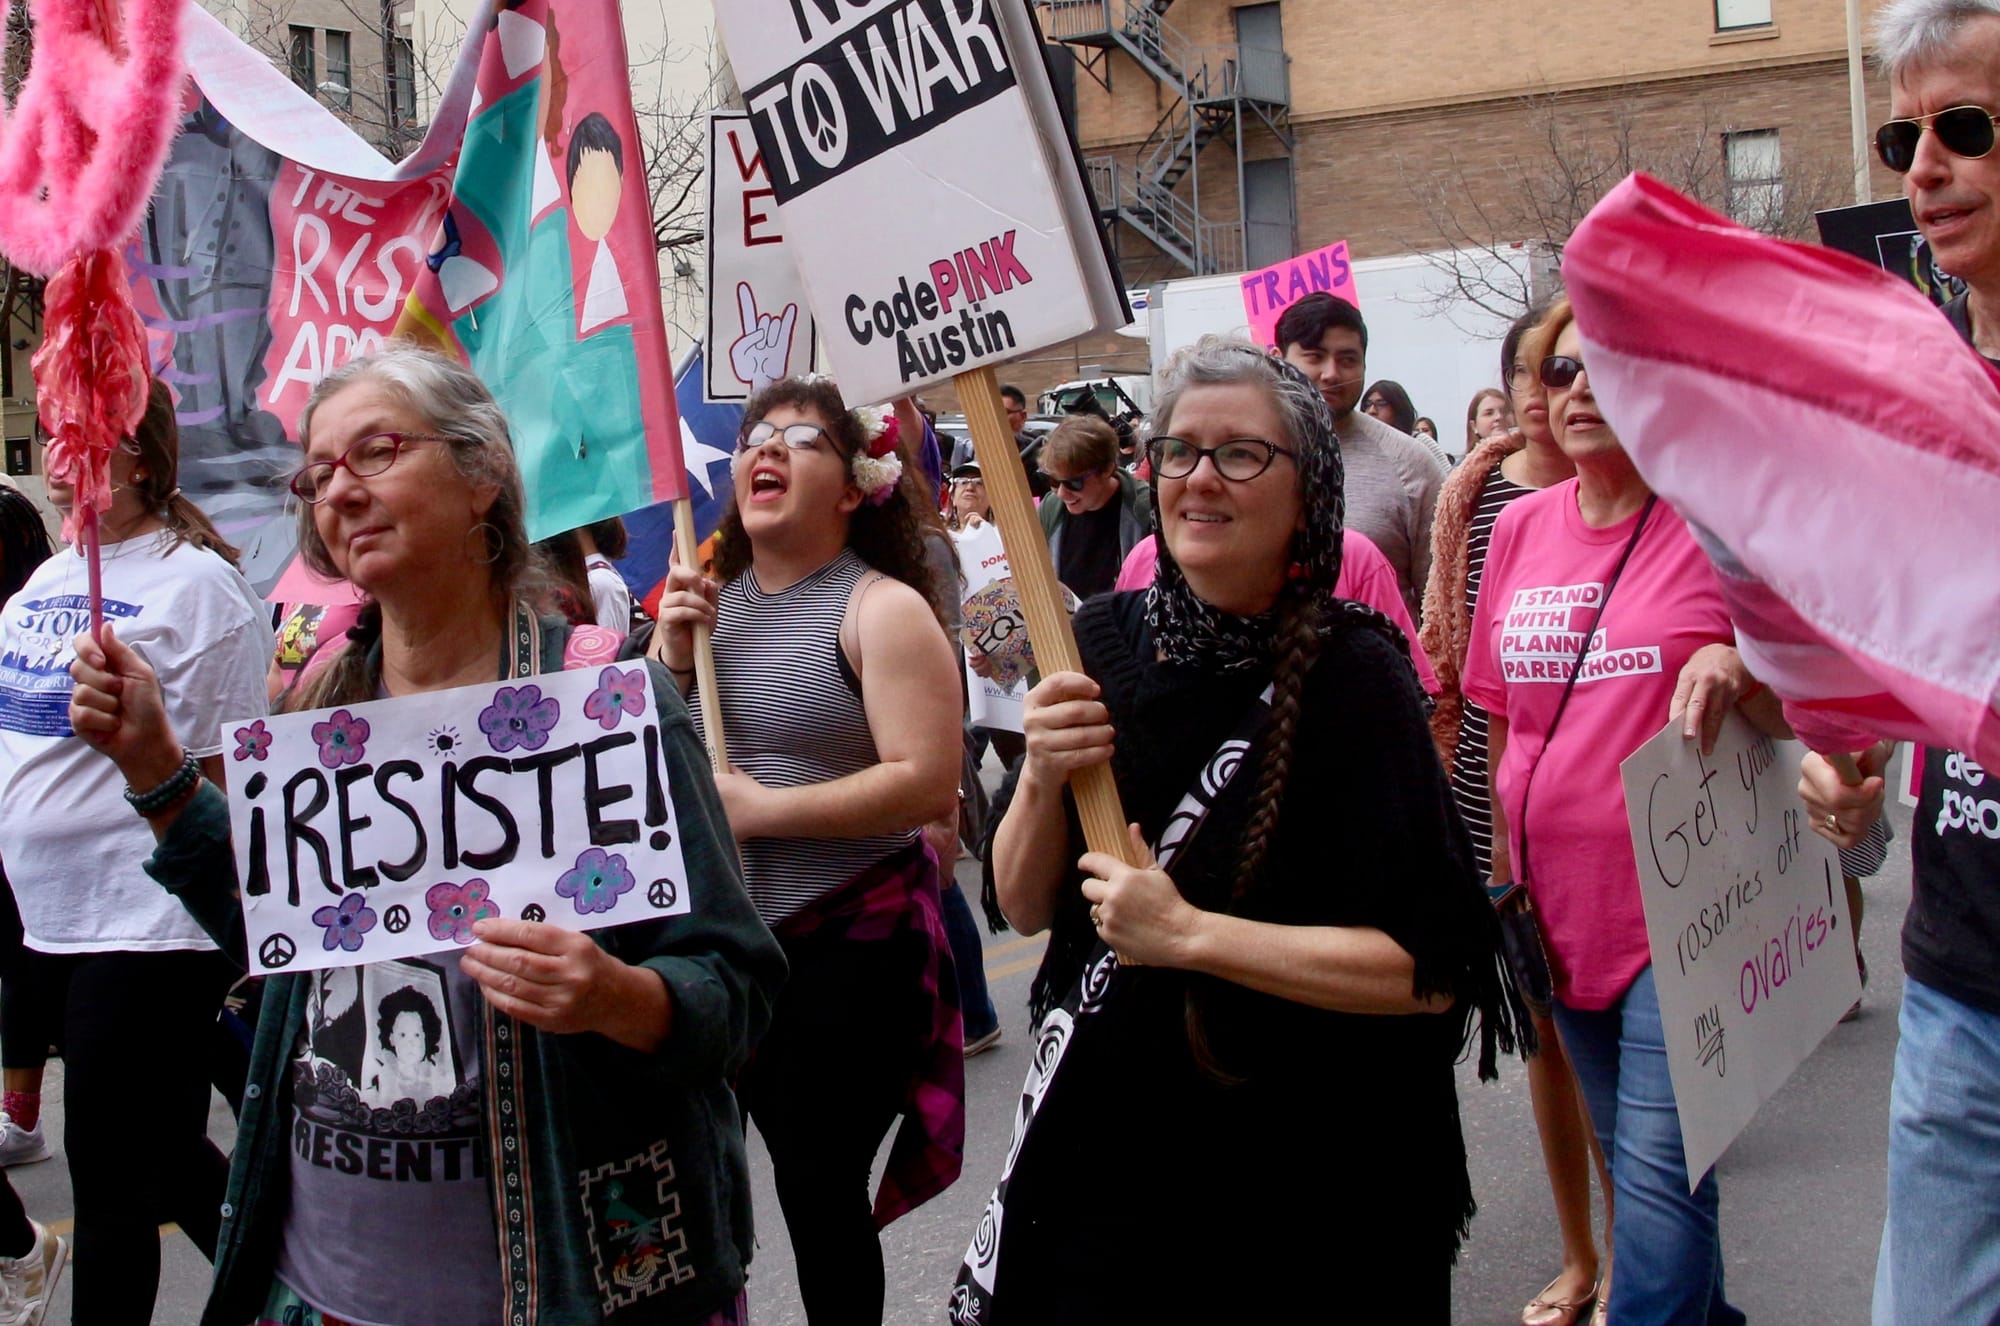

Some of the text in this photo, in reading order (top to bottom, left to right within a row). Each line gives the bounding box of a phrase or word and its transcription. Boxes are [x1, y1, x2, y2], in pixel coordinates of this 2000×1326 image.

[750, 0, 1008, 185] TO WAR
[292, 165, 385, 226] THE
[845, 229, 1033, 345] CodePINK
[1243, 244, 1349, 315] TRANS
[896, 303, 1016, 383] Austin
[981, 552, 1009, 569] DOM
[1514, 586, 1599, 607] I STAND
[17, 610, 116, 636] STOW
[1509, 610, 1566, 628] WITH
[245, 725, 672, 907] ¡RESISTE!
[1648, 748, 1718, 888] Get
[1677, 808, 1800, 977] rosaries off
[1694, 857, 1837, 1078] my ovaries!
